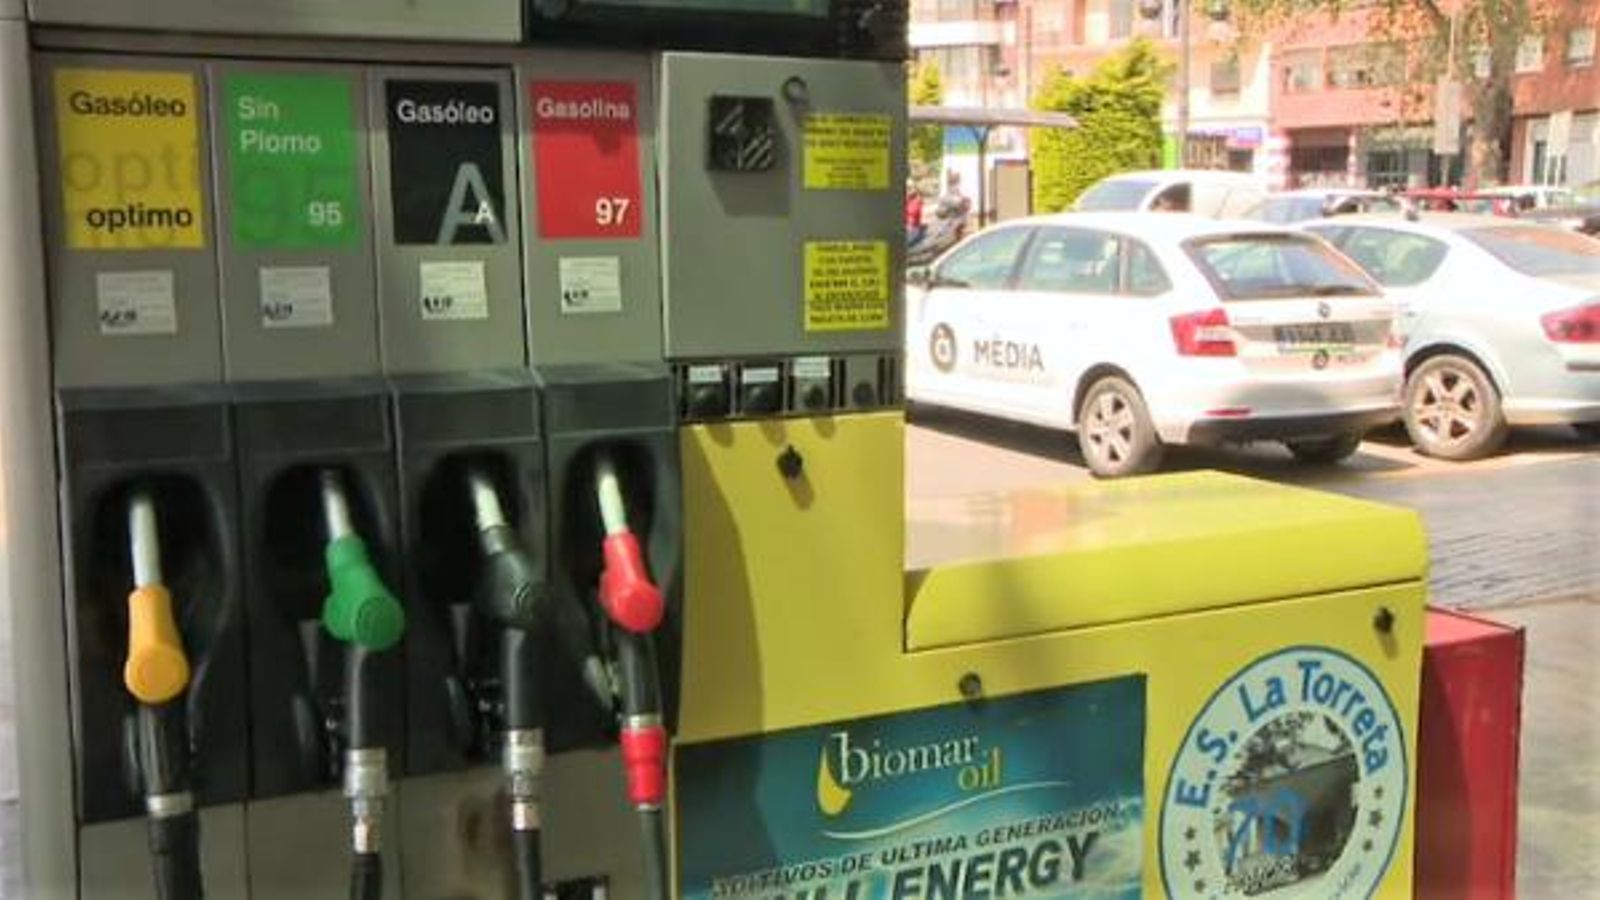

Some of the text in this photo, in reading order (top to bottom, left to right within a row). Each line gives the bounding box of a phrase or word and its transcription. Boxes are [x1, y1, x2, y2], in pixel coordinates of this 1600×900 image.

[69, 89, 186, 117] Gasóleo
[238, 95, 280, 121] Sin
[397, 99, 494, 124] Gasóleo
[536, 97, 630, 120] Gasolina
[240, 129, 322, 154] Plomo
[308, 200, 342, 227] 95
[436, 162, 508, 245] A
[474, 201, 494, 224] A
[595, 197, 630, 224] 97
[86, 202, 192, 233] optimo
[1238, 675, 1287, 723] La
[1297, 660, 1389, 775] Torreta
[831, 731, 980, 783] biomar
[958, 746, 1002, 791] oil
[841, 852, 874, 875] DE
[893, 831, 1099, 900] ENERGY
